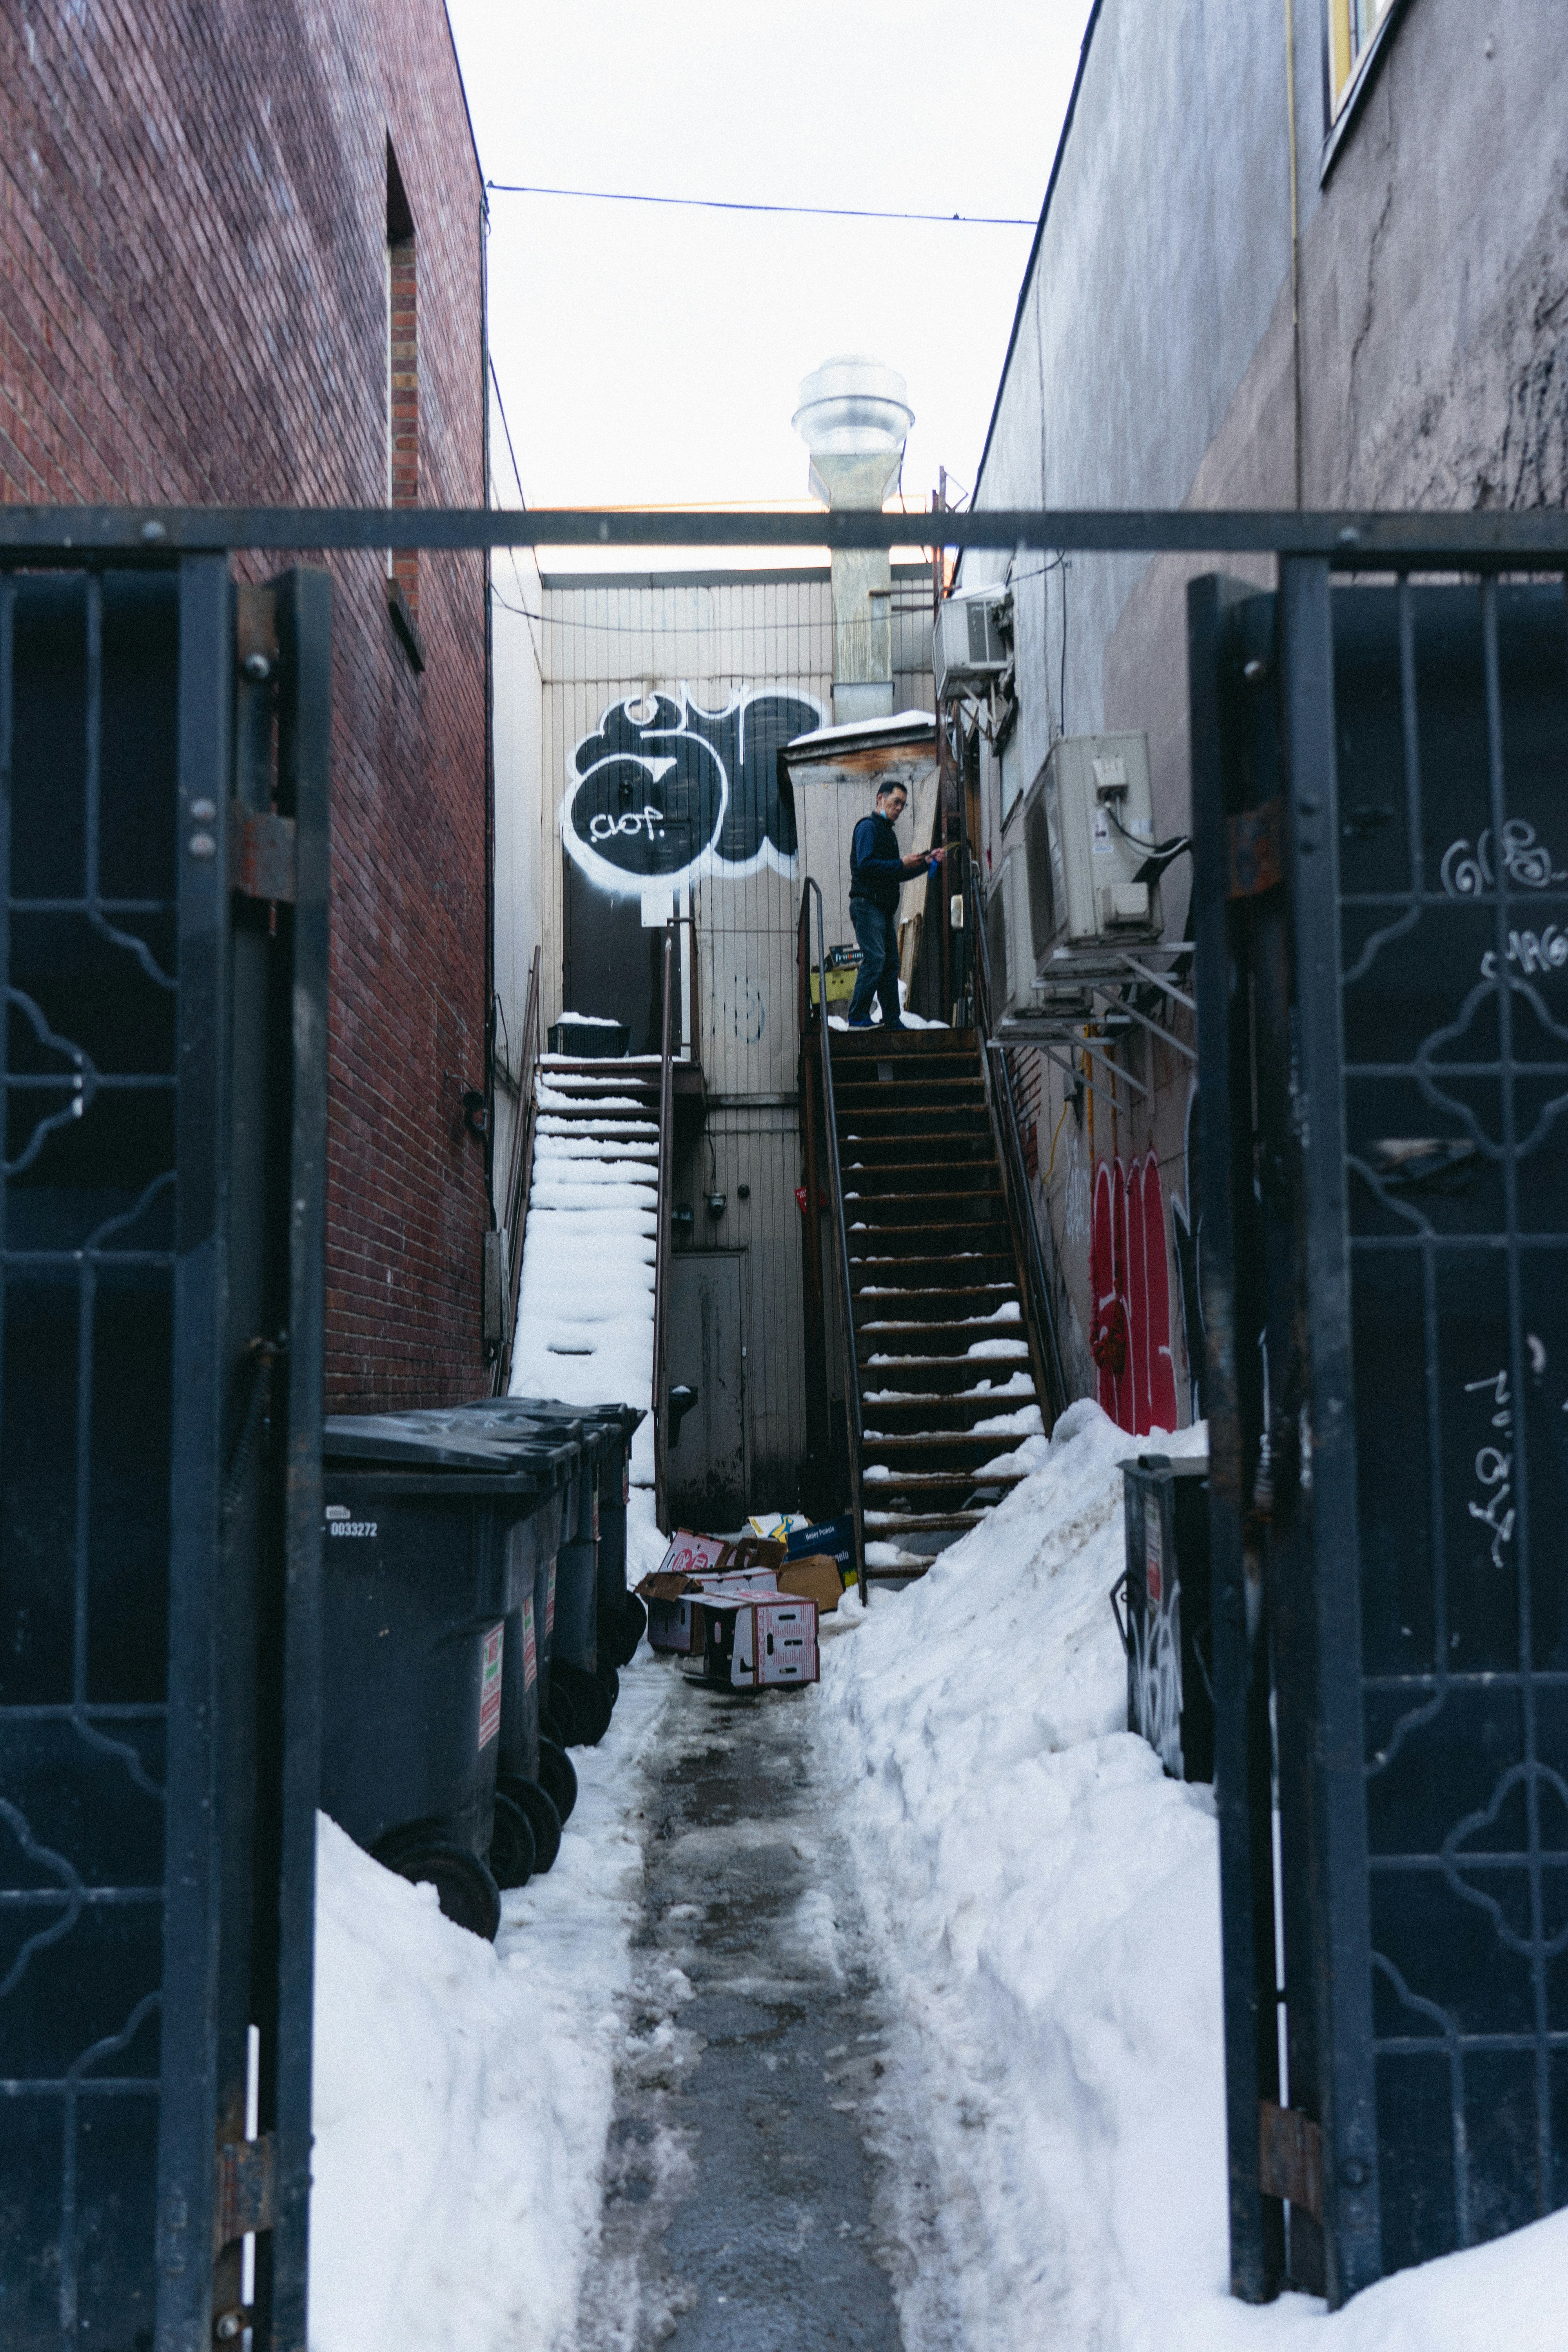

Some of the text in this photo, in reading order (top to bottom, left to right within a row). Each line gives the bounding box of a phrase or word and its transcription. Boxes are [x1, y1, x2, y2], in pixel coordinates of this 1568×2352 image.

[330, 1522, 377, 1537] 0033272
[806, 1526, 835, 1541] Honey Pomelo
